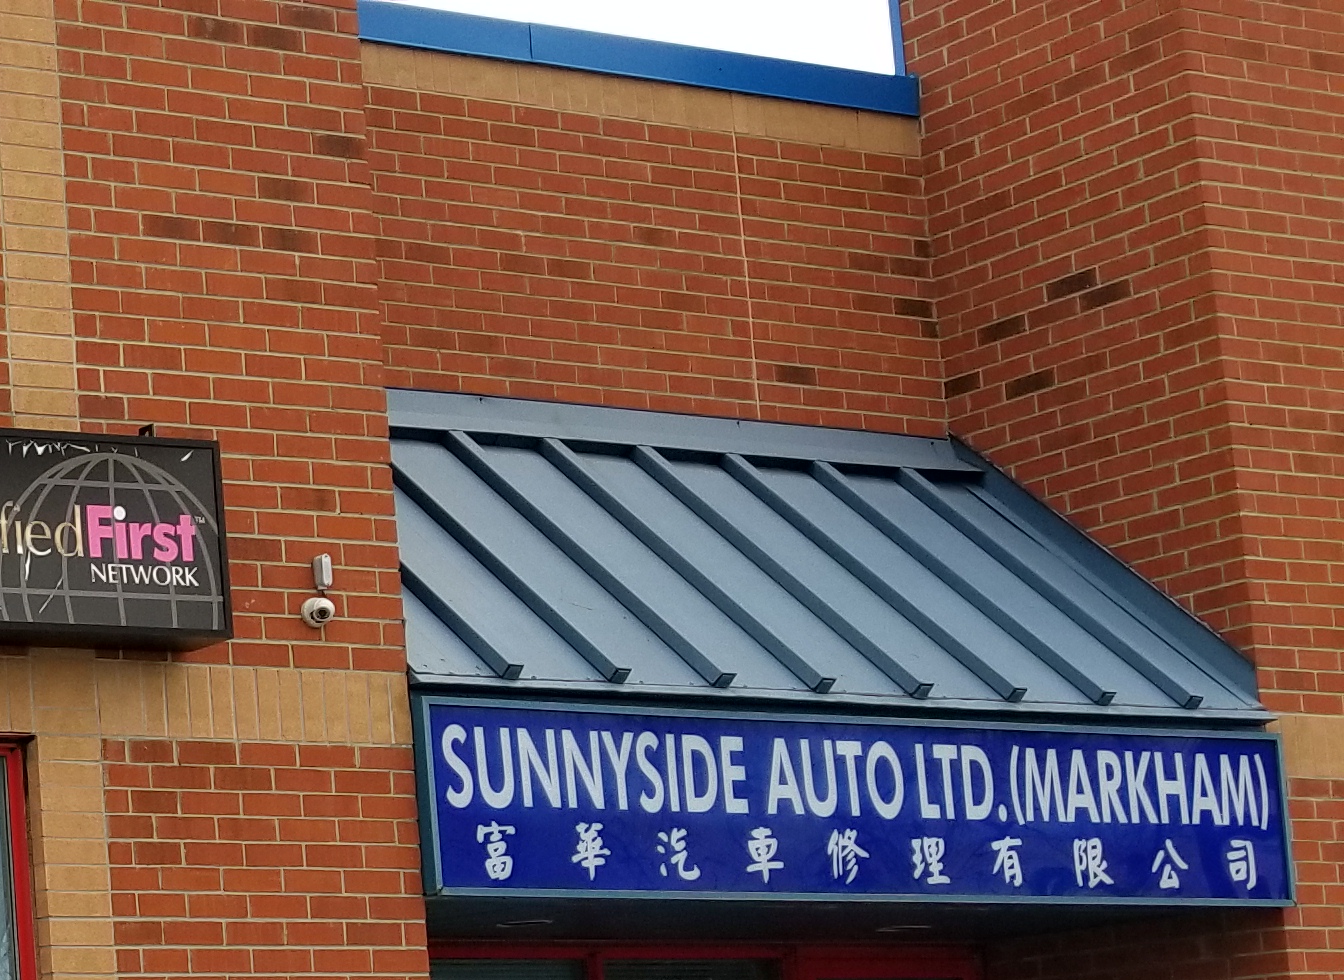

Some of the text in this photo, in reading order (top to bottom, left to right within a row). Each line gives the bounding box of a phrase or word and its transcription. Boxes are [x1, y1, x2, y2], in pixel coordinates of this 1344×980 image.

[90, 562, 200, 587] NETWORK
[441, 723, 750, 814] SUNNYSIDE
[767, 737, 905, 820] AUTO
